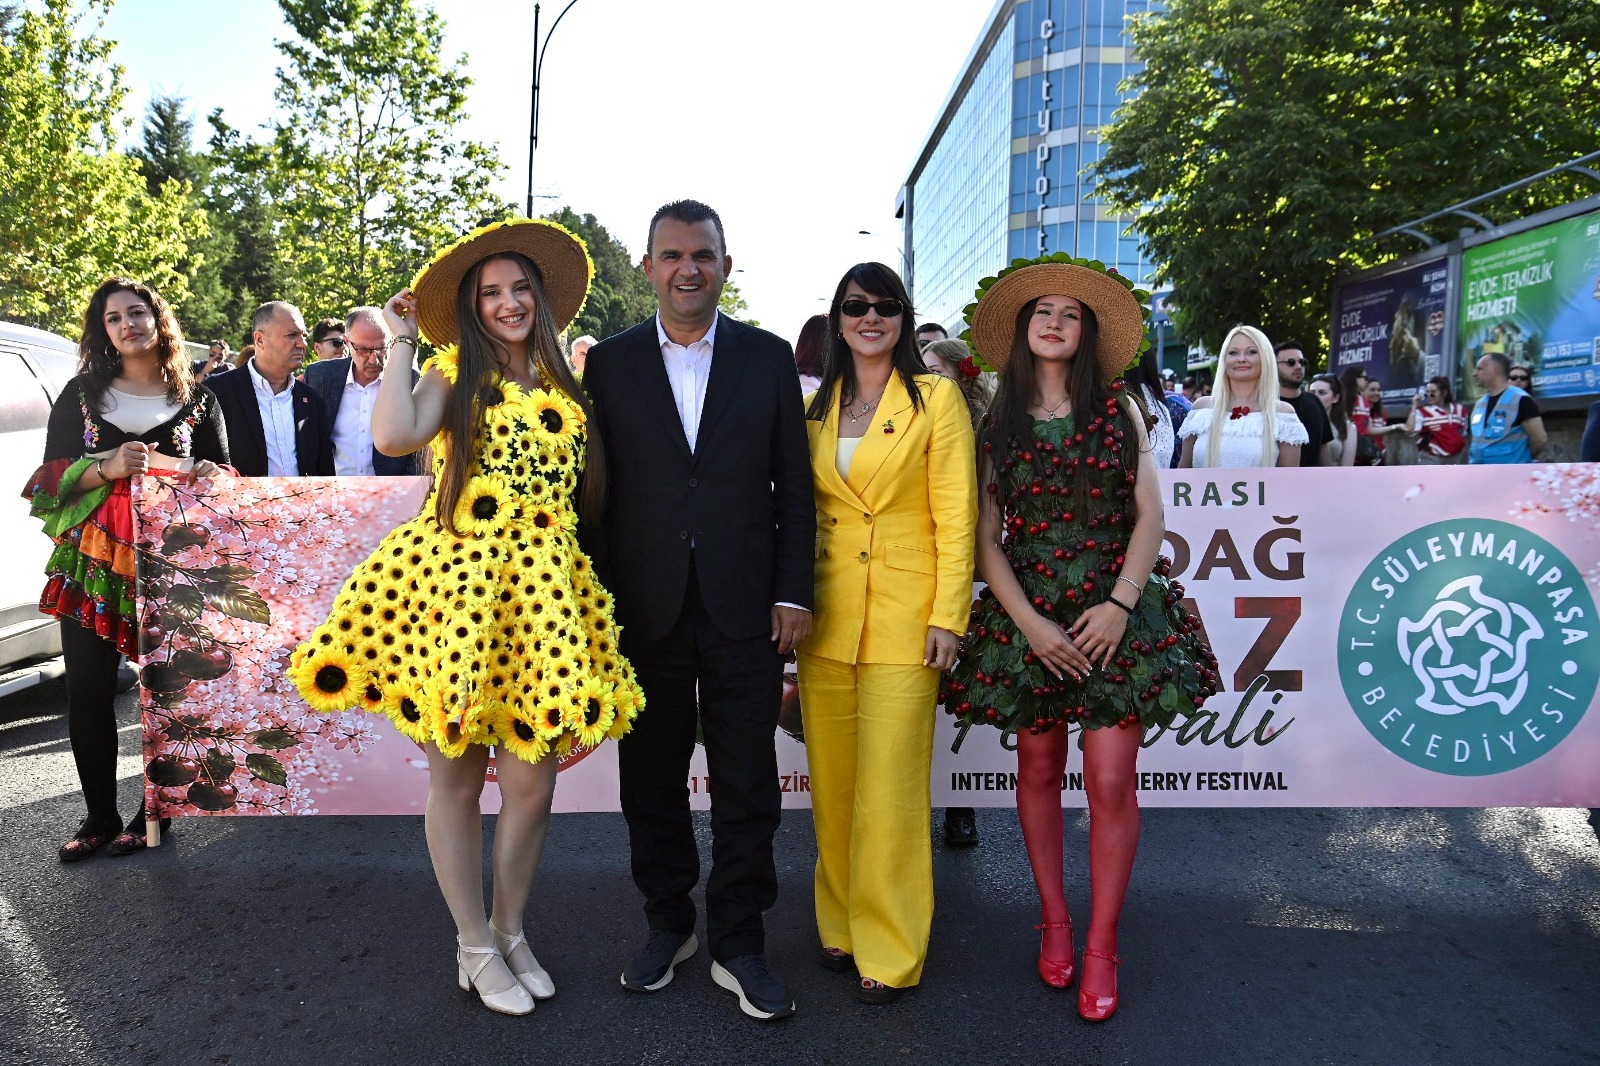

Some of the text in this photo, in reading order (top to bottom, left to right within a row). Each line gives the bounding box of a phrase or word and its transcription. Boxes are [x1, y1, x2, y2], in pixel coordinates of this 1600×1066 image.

[1468, 275, 1500, 300] EVDE
[1502, 259, 1555, 291] TEMİZLİK
[1341, 310, 1362, 329] EVDE
[1466, 290, 1517, 322] HİZMETİ
[1173, 481, 1265, 507] RASI
[1163, 515, 1306, 581] DAĞ
[1371, 531, 1589, 645] SÜLEYMANPAŞA
[1361, 685, 1576, 763] BELEDİYESİ
[1196, 771, 1288, 790] FESTIVAL
